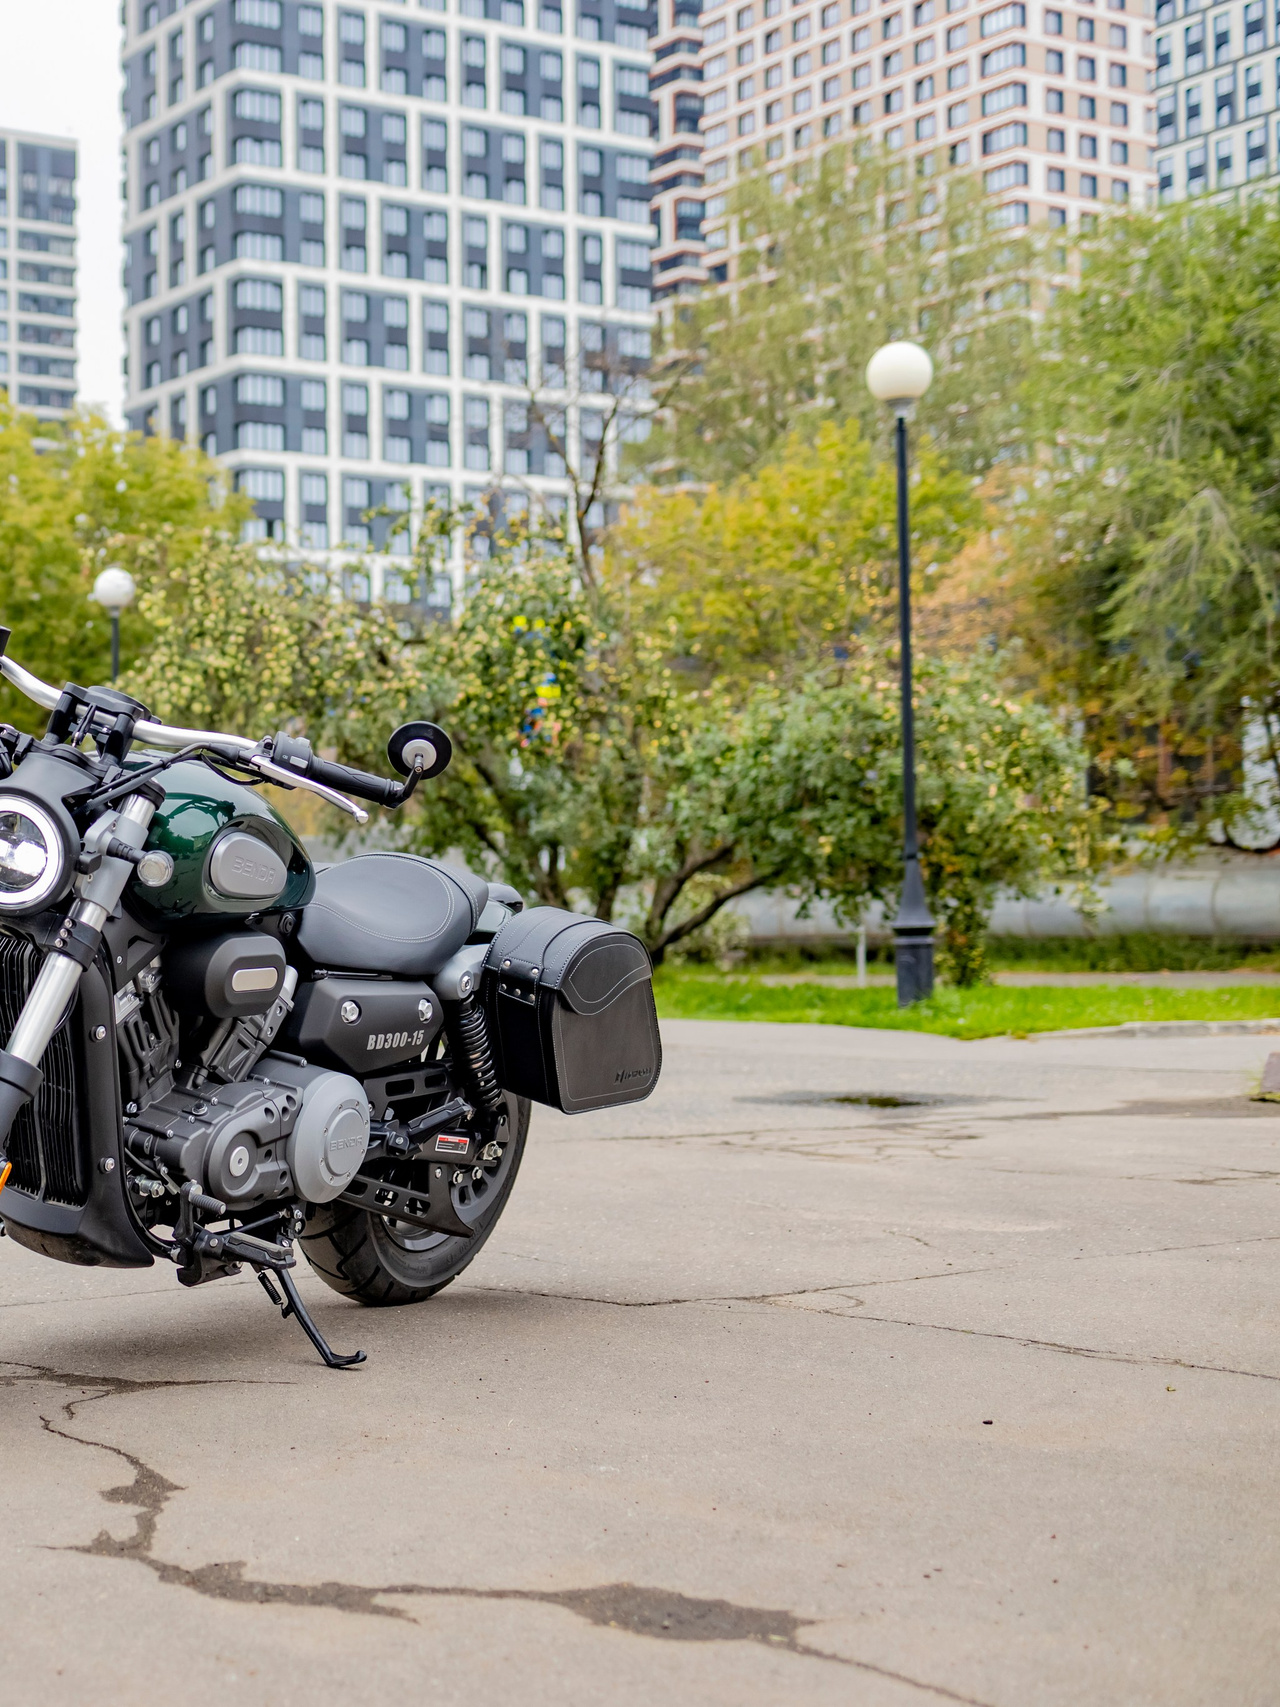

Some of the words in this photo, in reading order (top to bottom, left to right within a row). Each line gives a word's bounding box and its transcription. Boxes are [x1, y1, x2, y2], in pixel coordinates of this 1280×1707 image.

[232, 856, 276, 885] BENDA
[366, 1029, 425, 1051] BD300-15
[329, 1135, 363, 1151] BENDA
